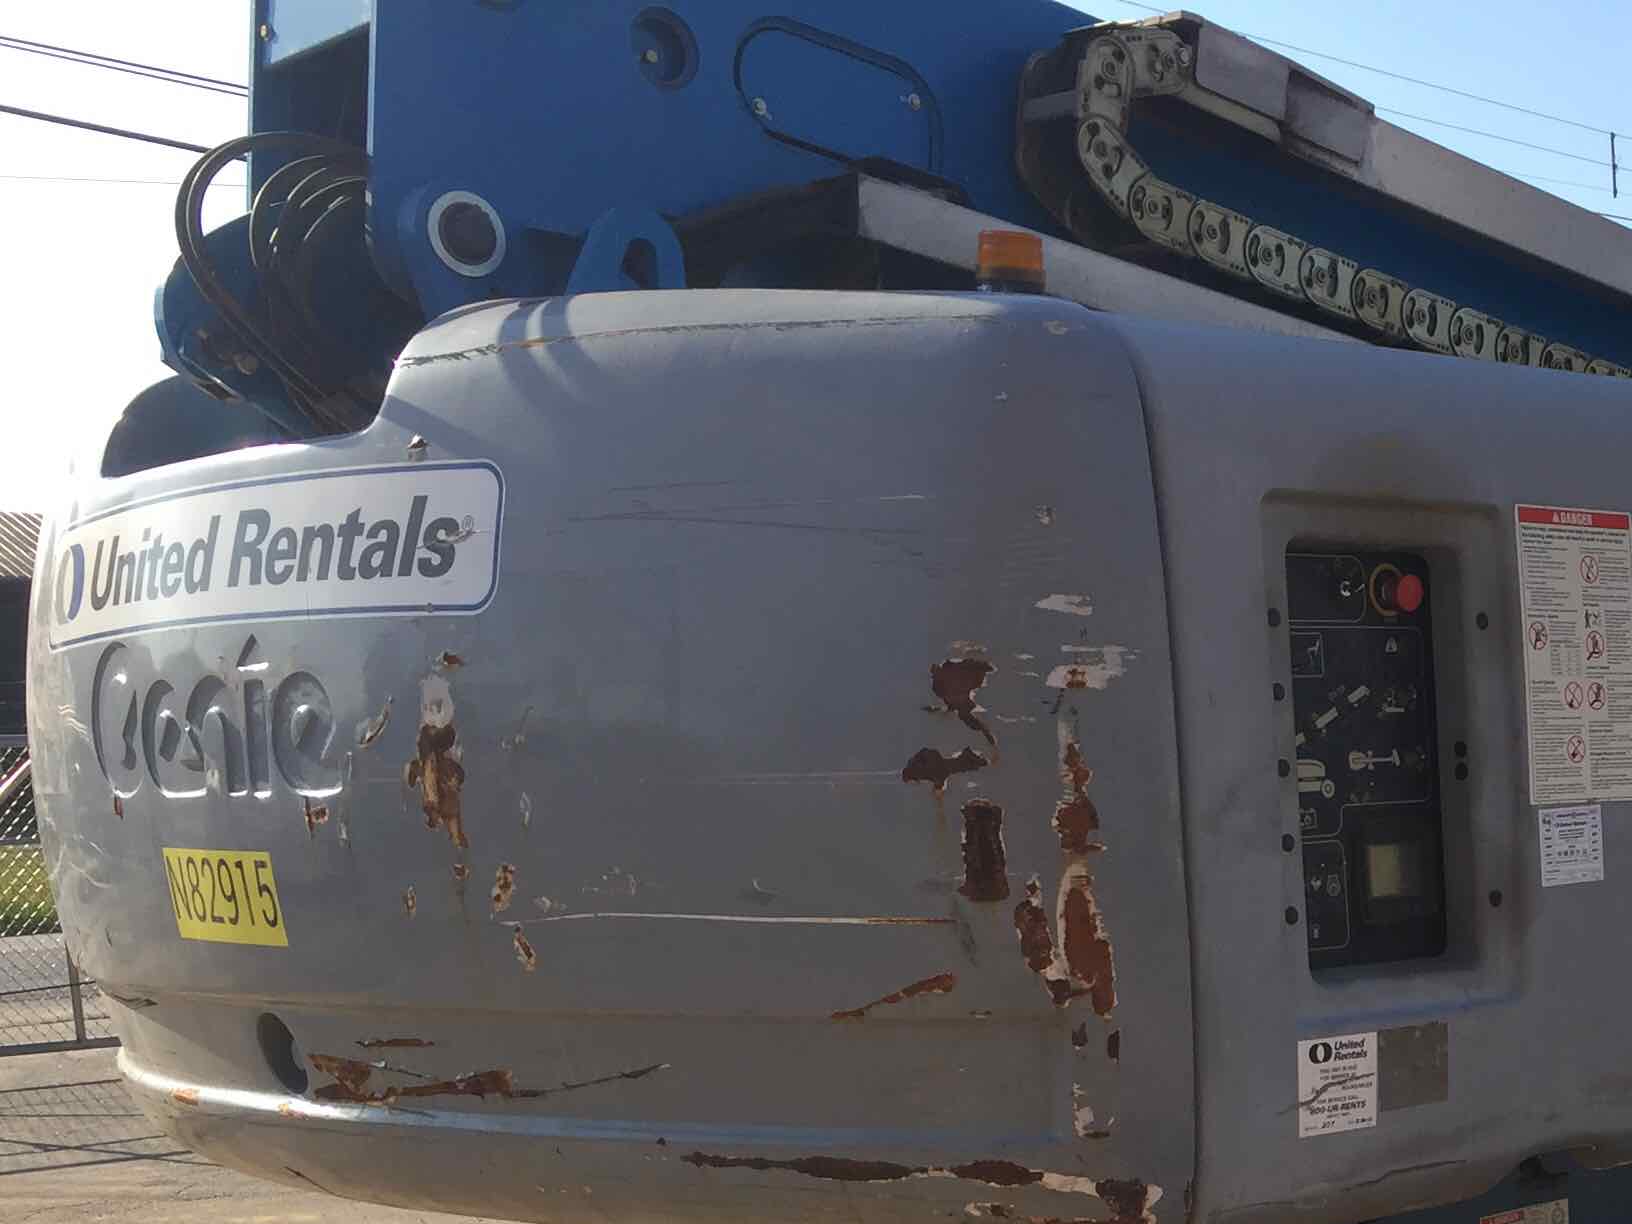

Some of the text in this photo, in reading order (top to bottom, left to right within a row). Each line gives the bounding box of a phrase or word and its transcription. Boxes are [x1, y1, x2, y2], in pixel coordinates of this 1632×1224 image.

[90, 495, 460, 612] United Rentals
[165, 855, 280, 930] N82915
[1334, 1038, 1366, 1051] United
[1334, 1049, 1368, 1062] Rentals
